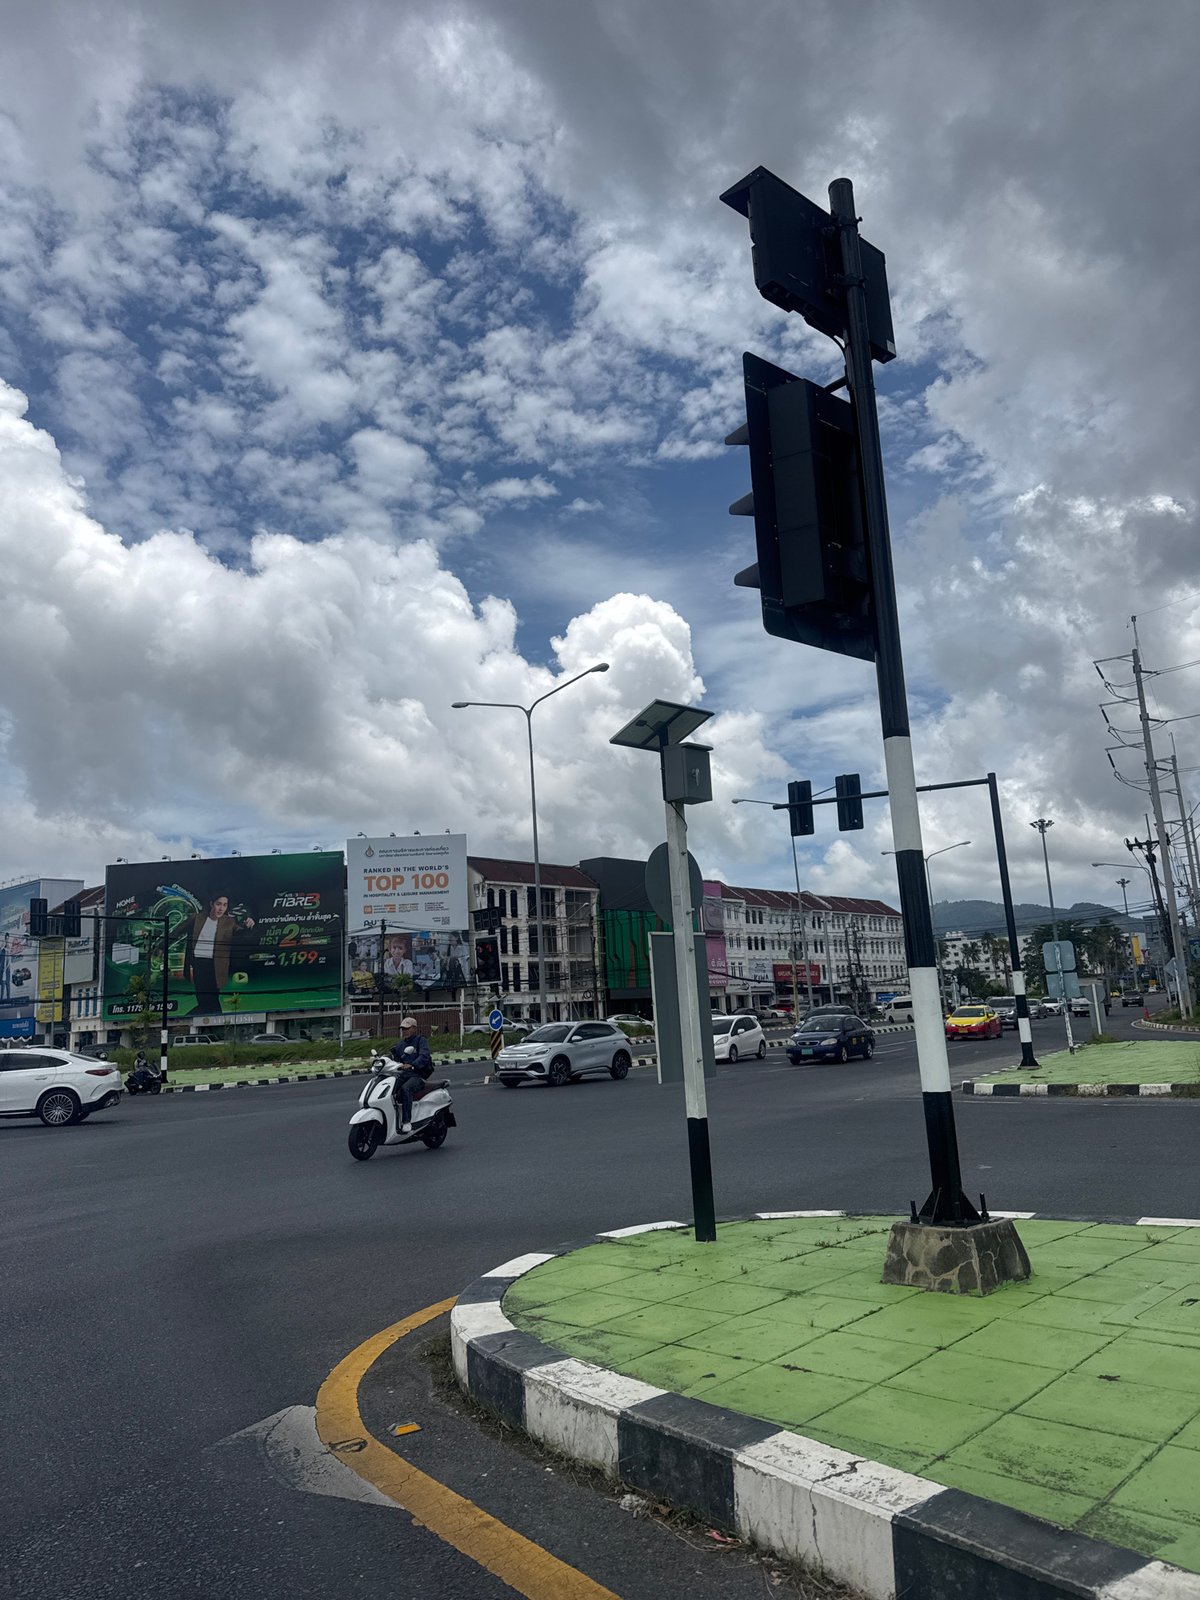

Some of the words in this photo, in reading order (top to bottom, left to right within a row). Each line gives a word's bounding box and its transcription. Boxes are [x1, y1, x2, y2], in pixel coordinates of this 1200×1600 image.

[363, 874, 405, 892] TOP
[411, 872, 449, 890] 100
[116, 896, 136, 909] HOME
[279, 951, 319, 966] 1,199
[127, 1004, 144, 1012] 1175
